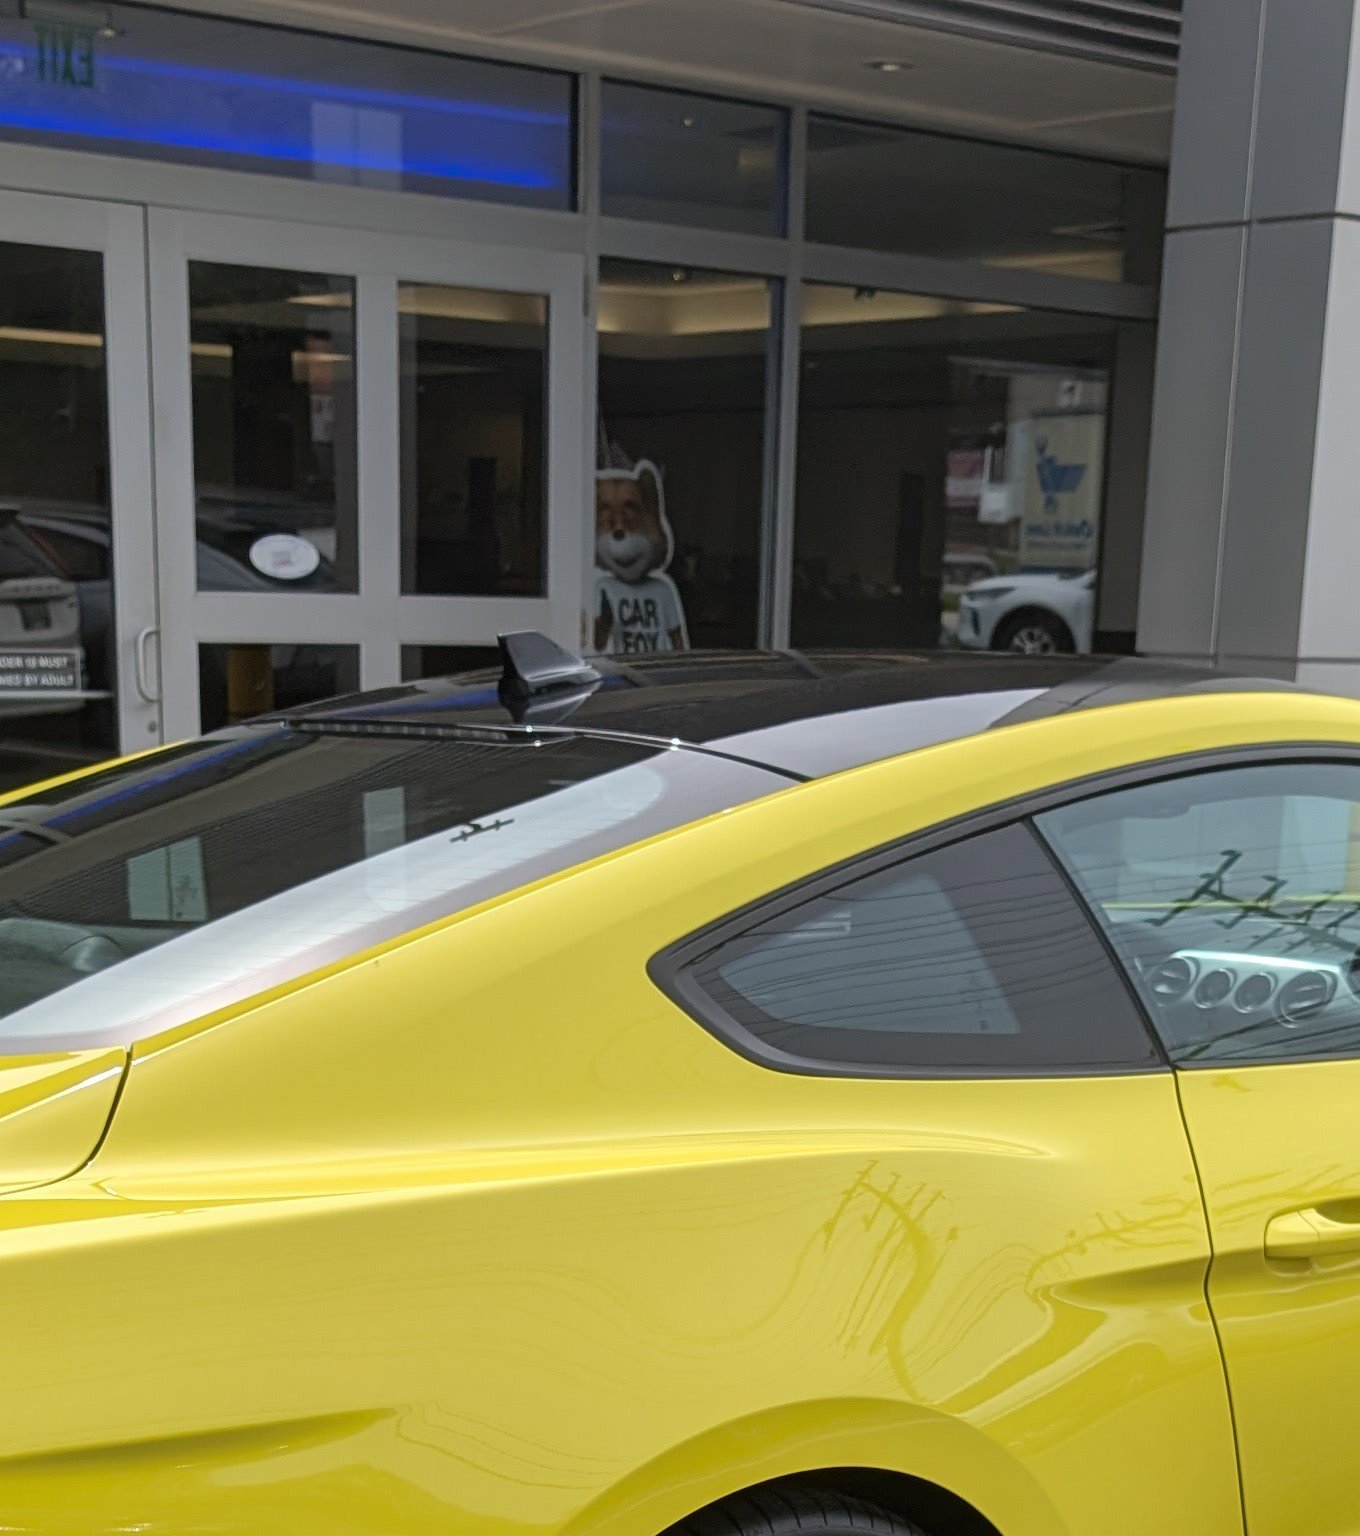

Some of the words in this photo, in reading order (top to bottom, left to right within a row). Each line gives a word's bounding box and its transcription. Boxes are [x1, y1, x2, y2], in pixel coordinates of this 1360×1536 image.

[619, 599, 659, 627] CAR
[39, 656, 68, 668] MUST
[40, 674, 74, 687] ADULT
